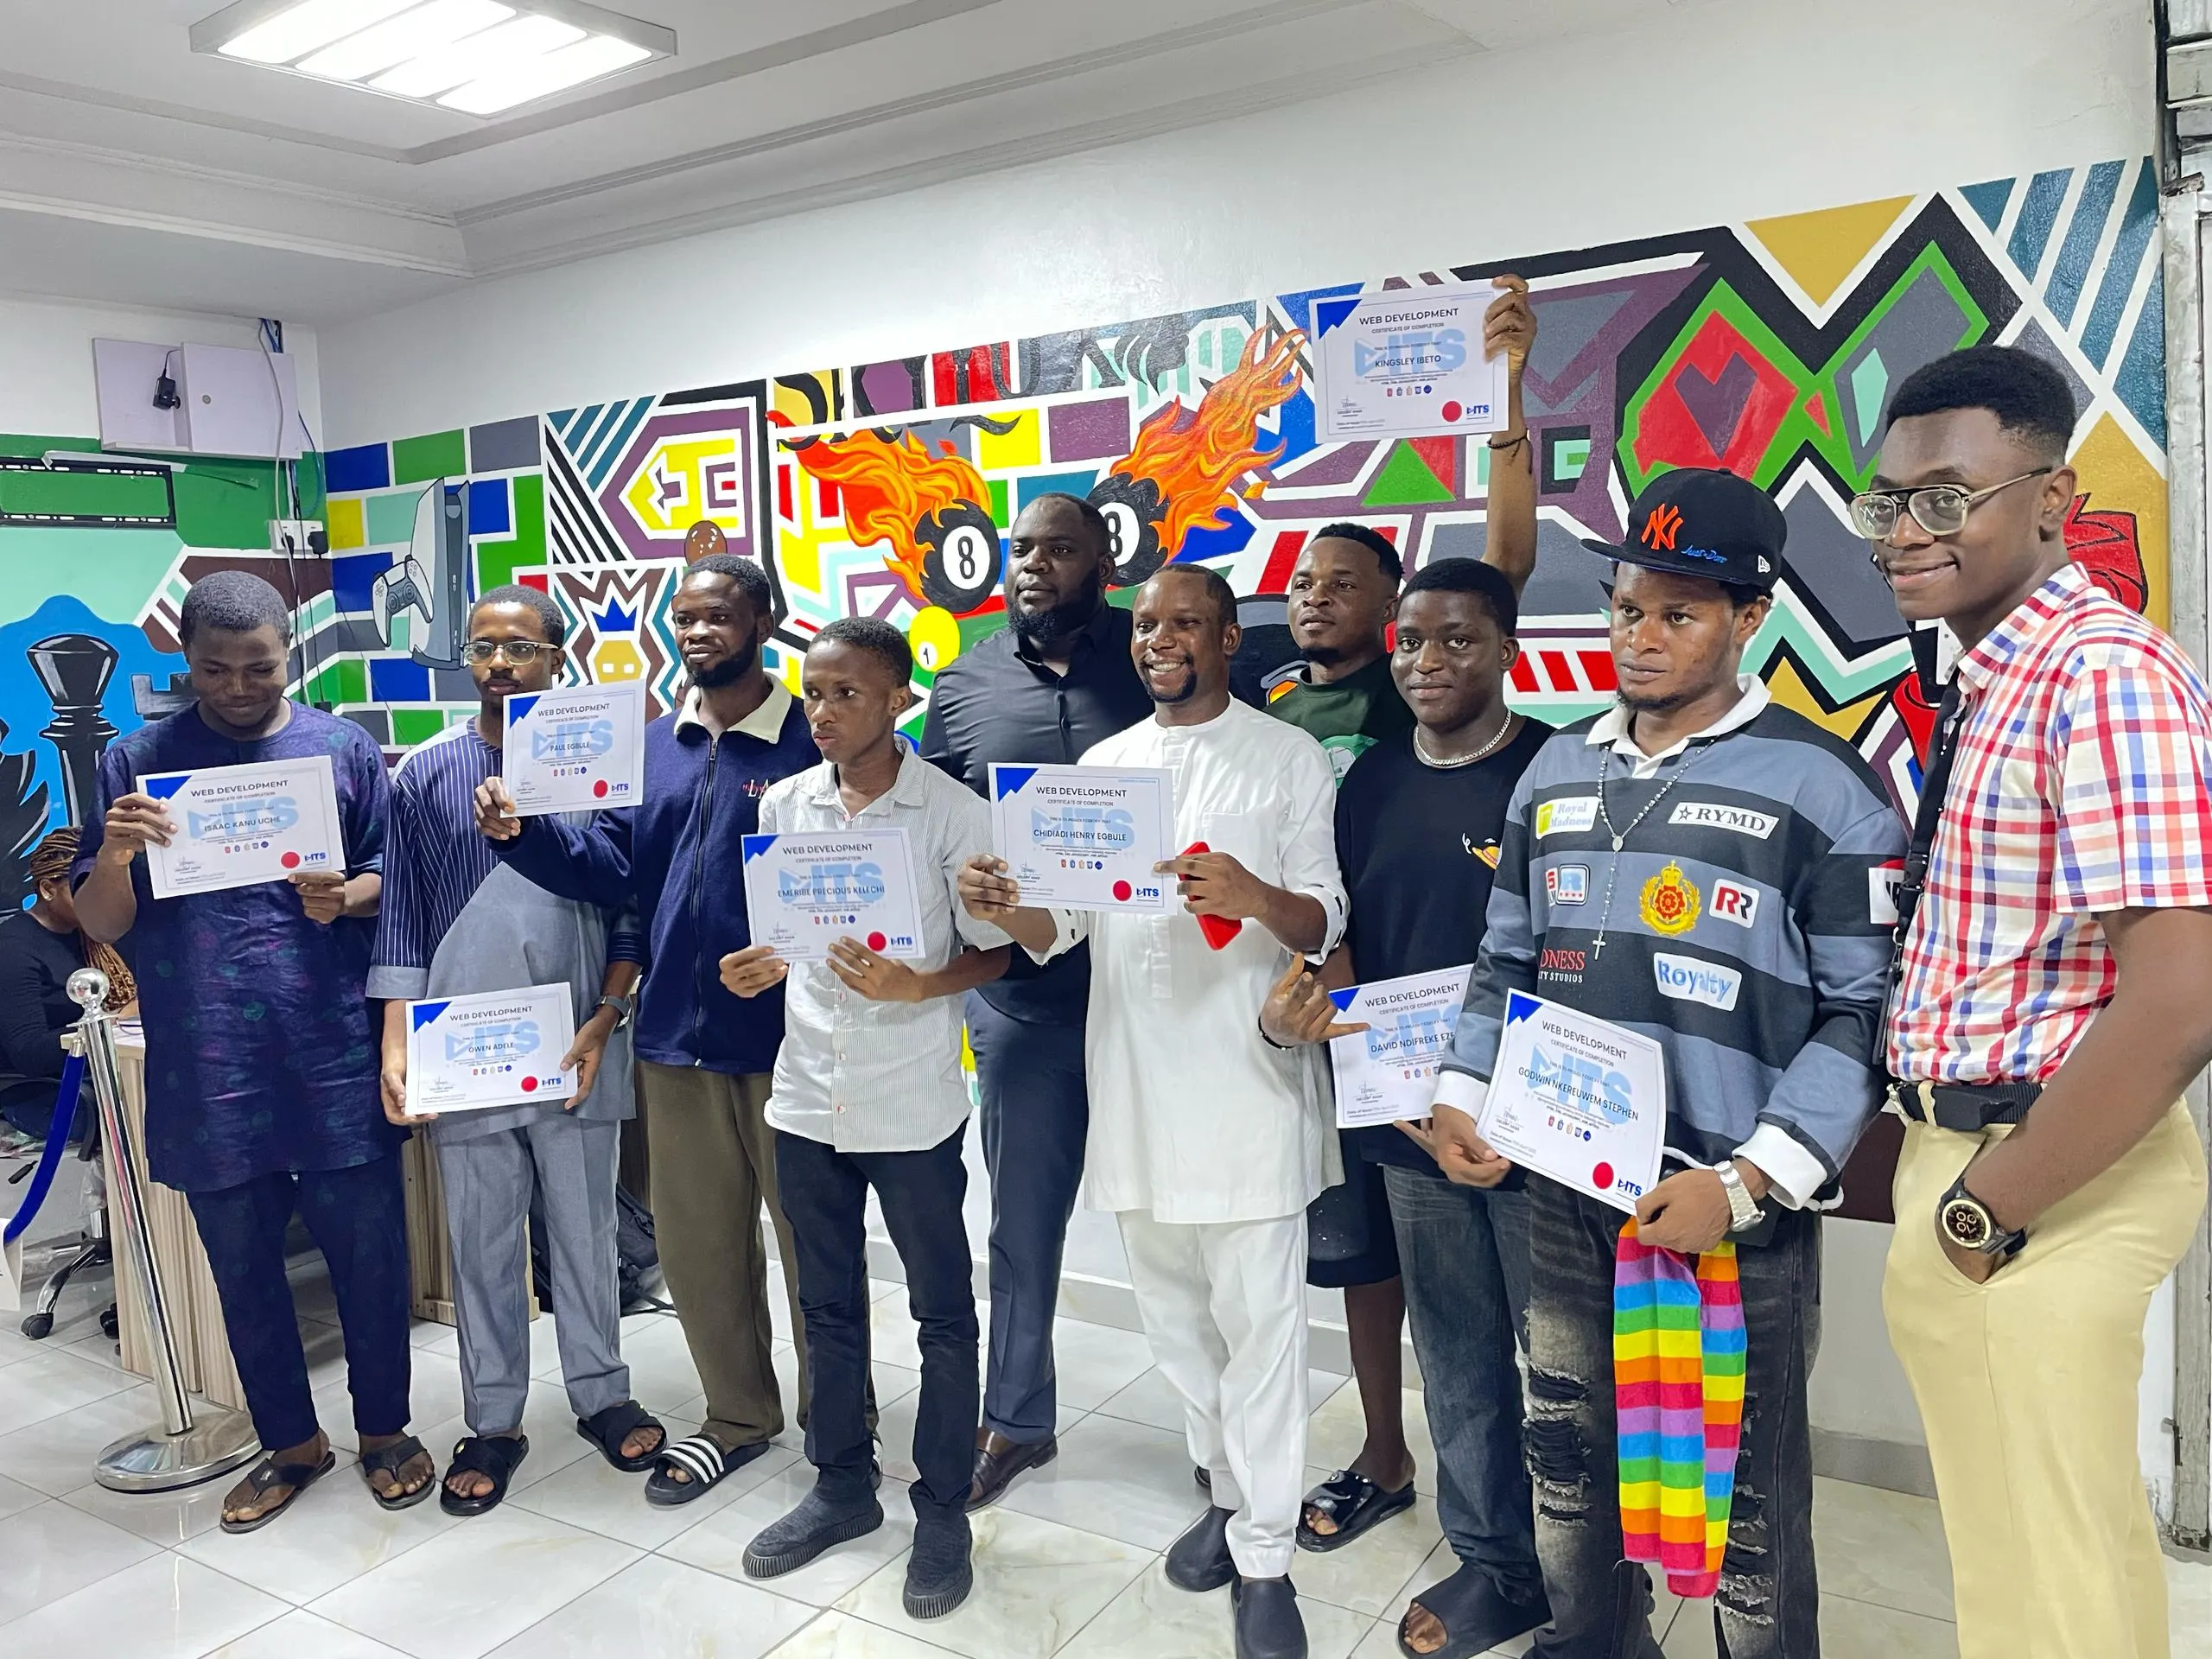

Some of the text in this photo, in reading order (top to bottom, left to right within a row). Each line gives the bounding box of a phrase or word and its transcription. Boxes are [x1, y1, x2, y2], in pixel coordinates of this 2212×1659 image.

[1359, 308, 1459, 325] WEB DEVELOPMENT
[1375, 354, 1441, 367] KINGSLEY IBETO
[1104, 511, 1123, 559] 8
[957, 536, 976, 580] 8
[923, 647, 930, 665] 1
[556, 702, 610, 715] DEVELOPMENT
[191, 779, 289, 797] WEB DEVELOPMENT
[1036, 786, 1127, 798] WEB DEVELOPMENT
[204, 816, 281, 832] ISAAC KANU UCHE
[1695, 808, 1766, 831] RYMD
[1033, 830, 1127, 842] CHIDIADI HENRY EGBULE
[782, 843, 873, 855] WEB DEVELOPMENT
[812, 887, 852, 896] PRECIOUS
[853, 885, 886, 894] KELECHI
[1549, 971, 1583, 983] STUDIOS
[1657, 960, 1732, 1002] Royalty
[1365, 983, 1459, 1007] WEB DEVELOPMENT
[450, 1006, 532, 1021] WEB DEVELOPMENT
[1379, 1006, 1409, 1014] CERTIFICATE
[1417, 999, 1449, 1008] COMPLETION
[1370, 1041, 1398, 1052] DAVID
[1400, 1034, 1438, 1048] NDIFREKE
[1542, 1020, 1561, 1035] WEB
[1564, 1028, 1627, 1060] DEVELOPMENT
[468, 1045, 491, 1053] OWEN
[1518, 1066, 1551, 1086] GODWIN
[1552, 1080, 1601, 1106] NKEREUWEM
[1603, 1099, 1638, 1121] STEPHEN
